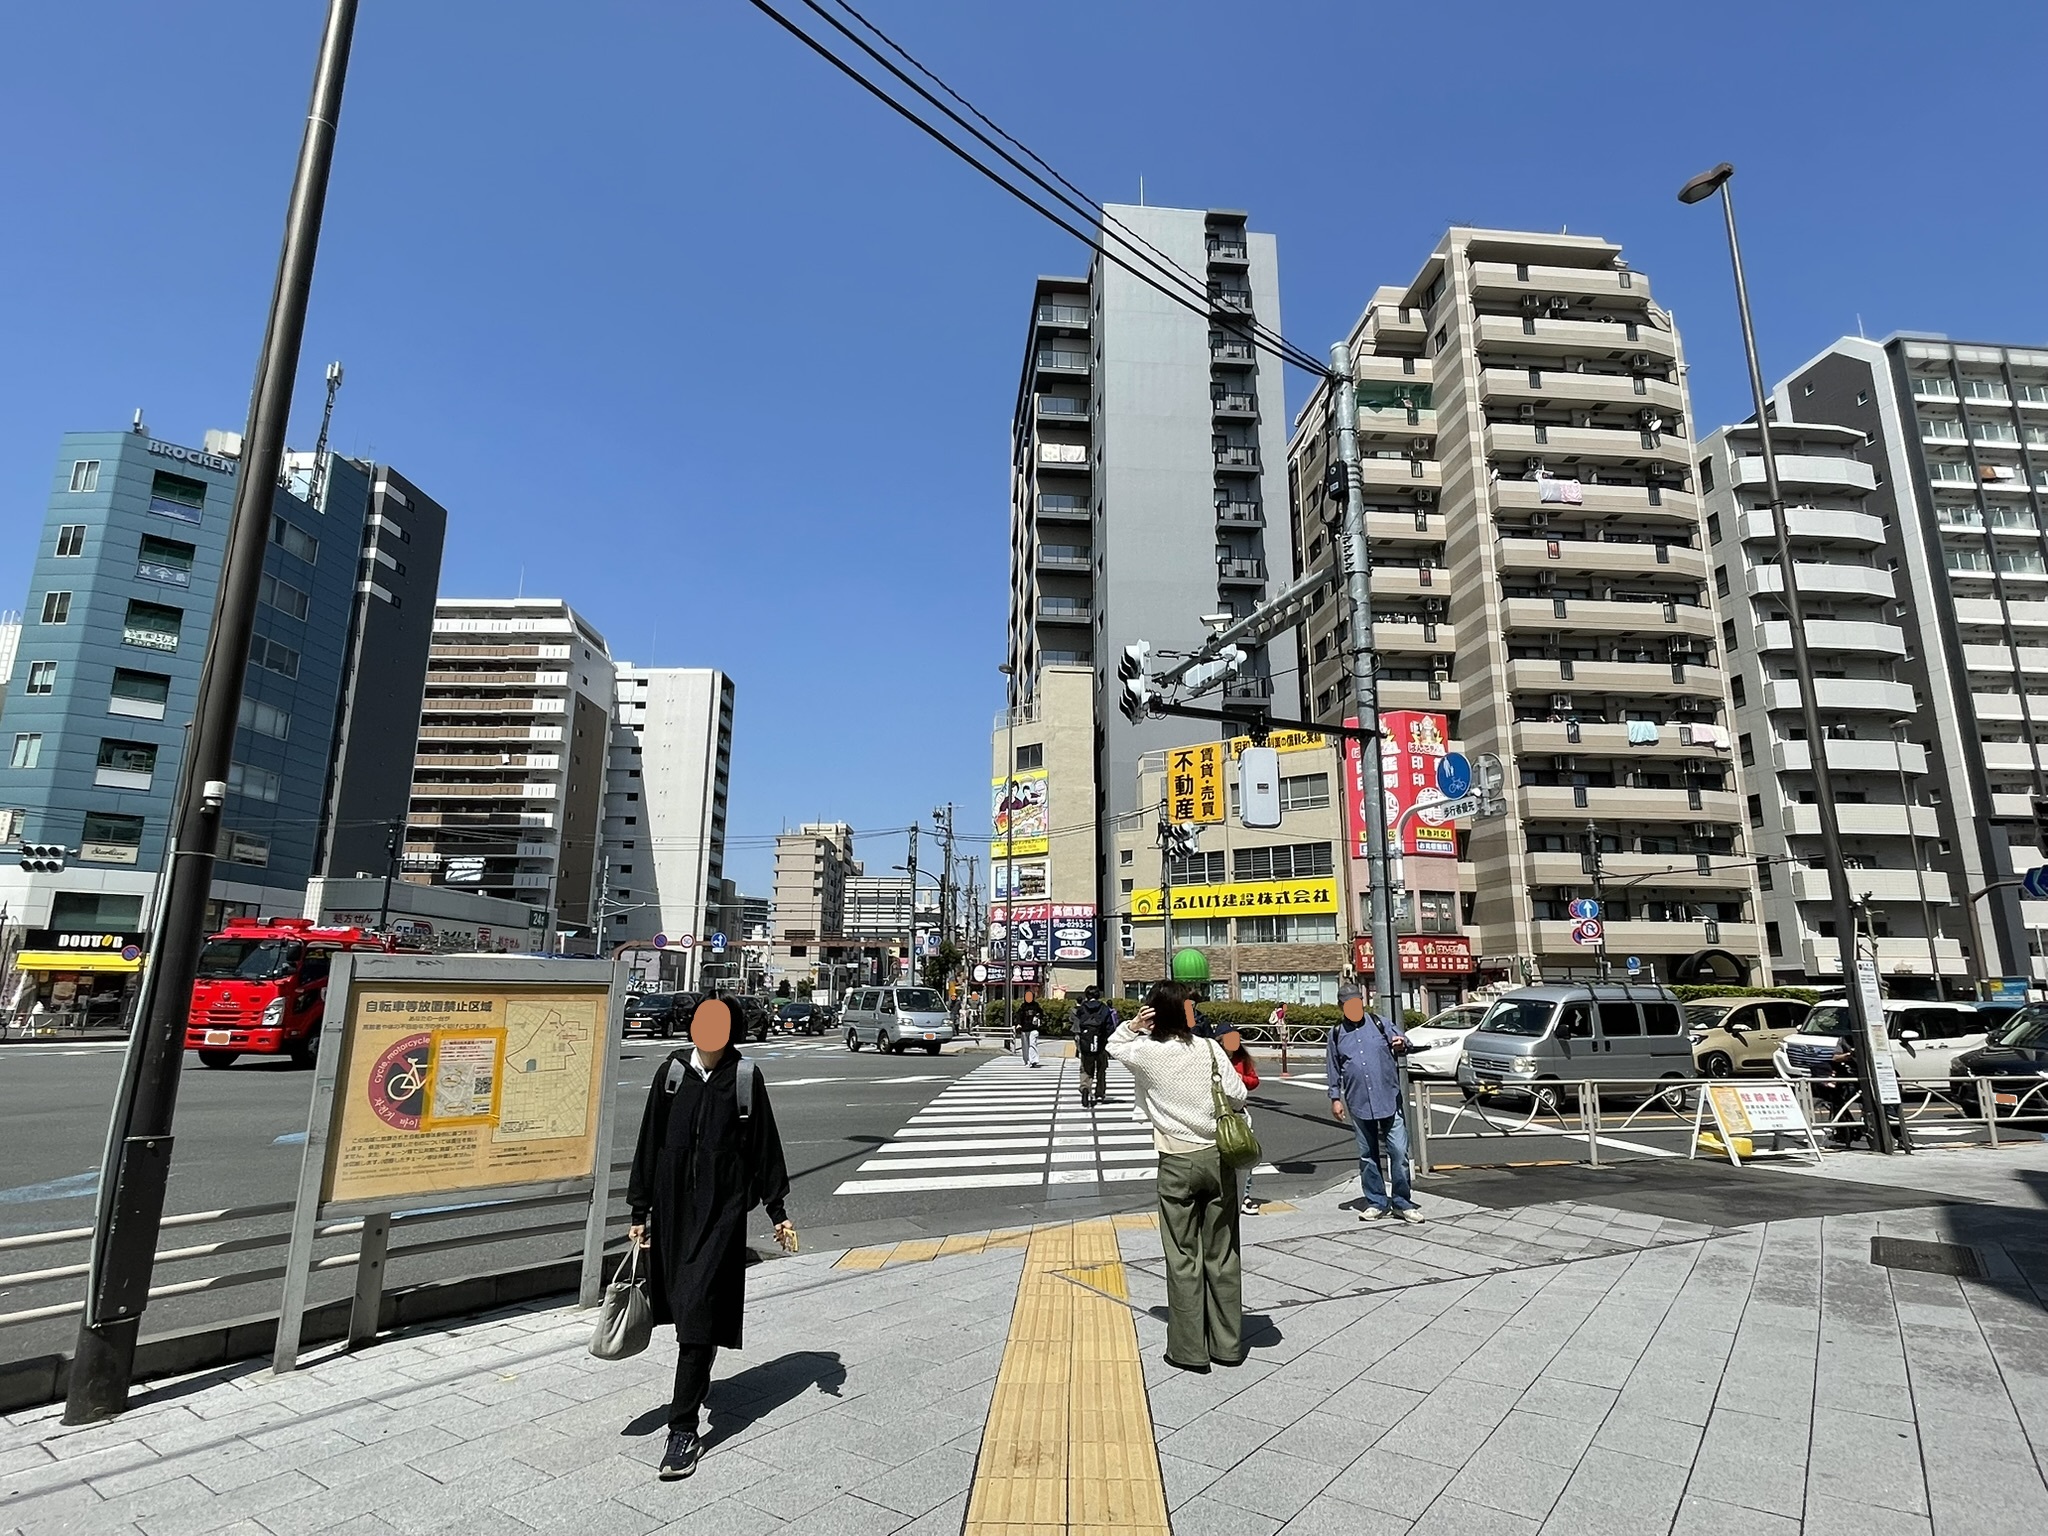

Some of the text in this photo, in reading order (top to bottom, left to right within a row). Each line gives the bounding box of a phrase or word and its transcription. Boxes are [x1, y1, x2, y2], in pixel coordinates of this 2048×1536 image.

[148, 439, 235, 474] BROCKEN
[1174, 750, 1194, 821] 不動産
[1200, 748, 1215, 817] 賃貸・売買
[1052, 906, 1094, 917] 高価買取
[58, 934, 124, 948] DOUTOR
[366, 1000, 493, 1012] 自転車等放置禁止区域
[386, 1036, 431, 1060] motorcycle
